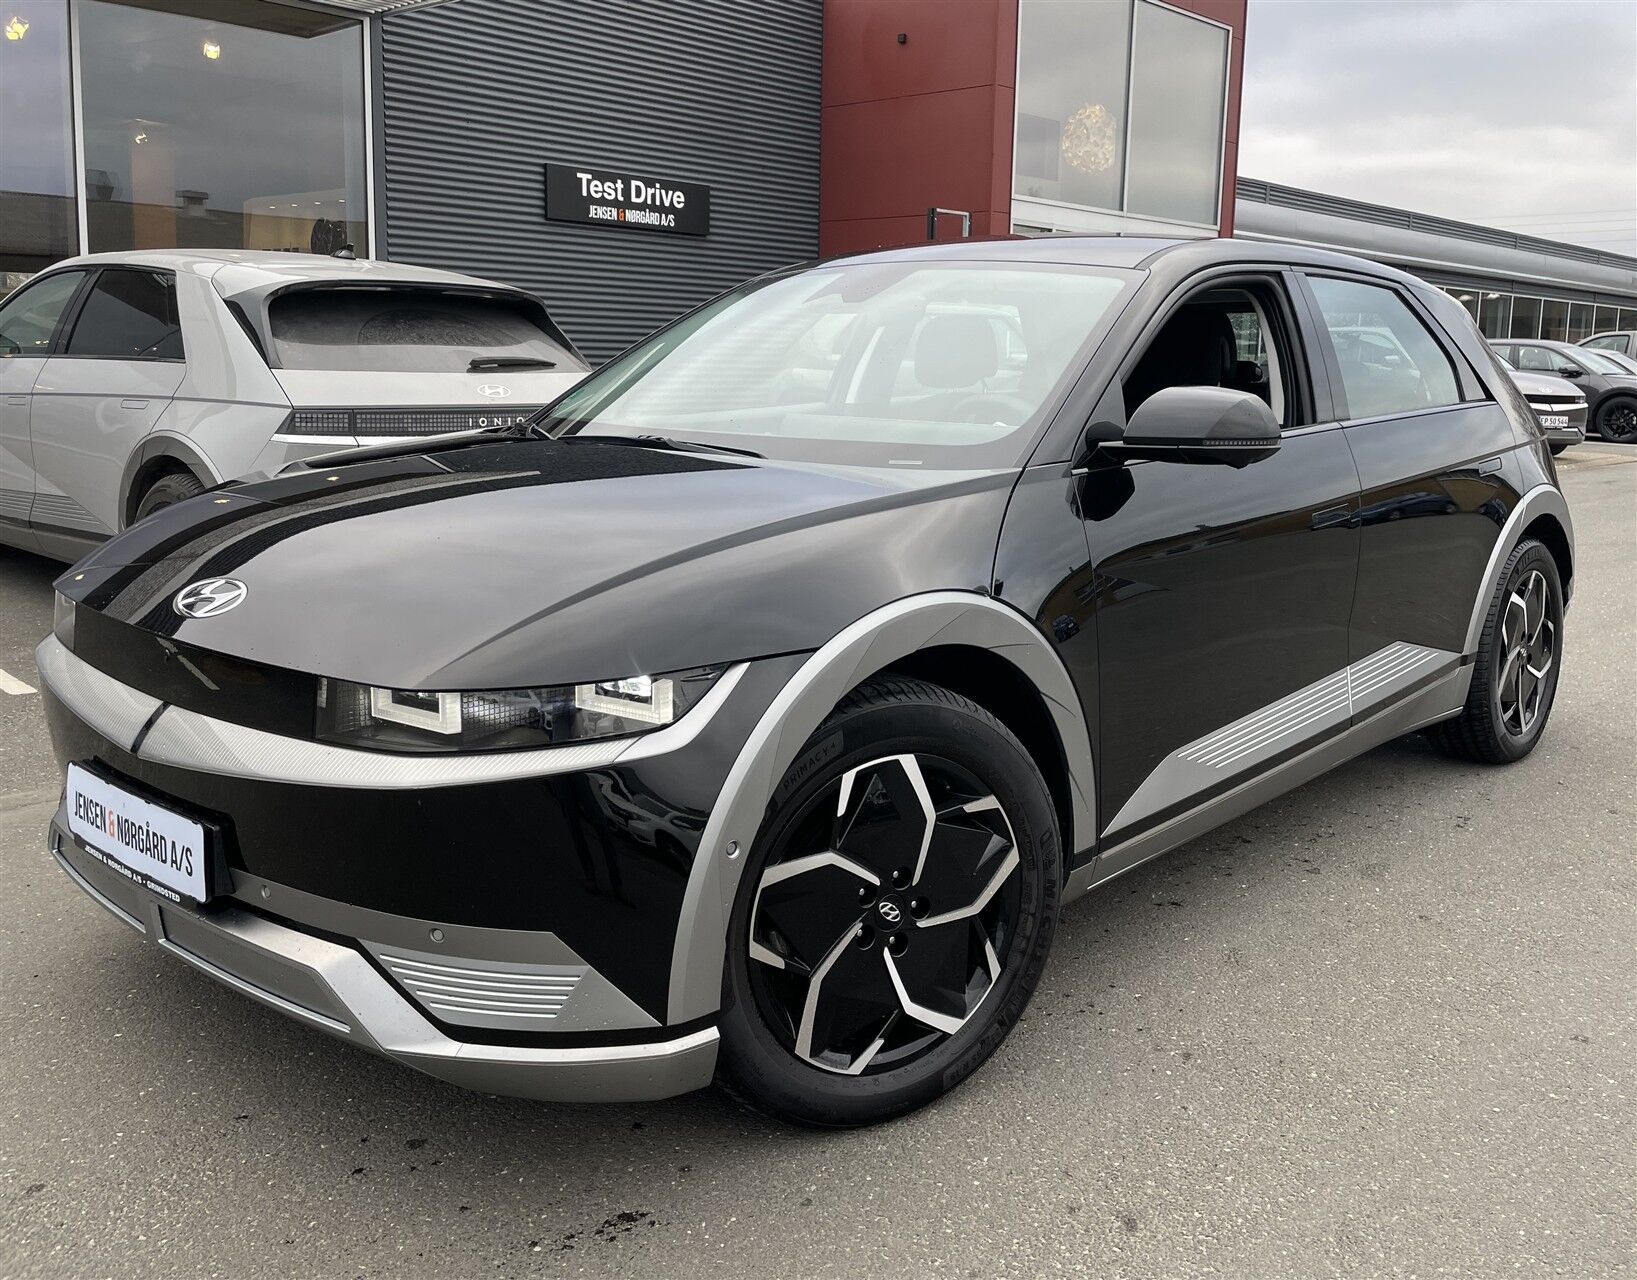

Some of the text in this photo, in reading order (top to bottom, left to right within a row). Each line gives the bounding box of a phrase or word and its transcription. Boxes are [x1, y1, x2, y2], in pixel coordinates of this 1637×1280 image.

[576, 172, 685, 209] Test Drive
[588, 204, 675, 227] JENSEN & NØRGÅRD A/S
[783, 744, 829, 791] PRIMACY
[74, 790, 194, 878] JENSEN & NØRGÅRD A/S
[84, 844, 103, 861] JENSEN
[146, 879, 181, 903] GRINDSTED
